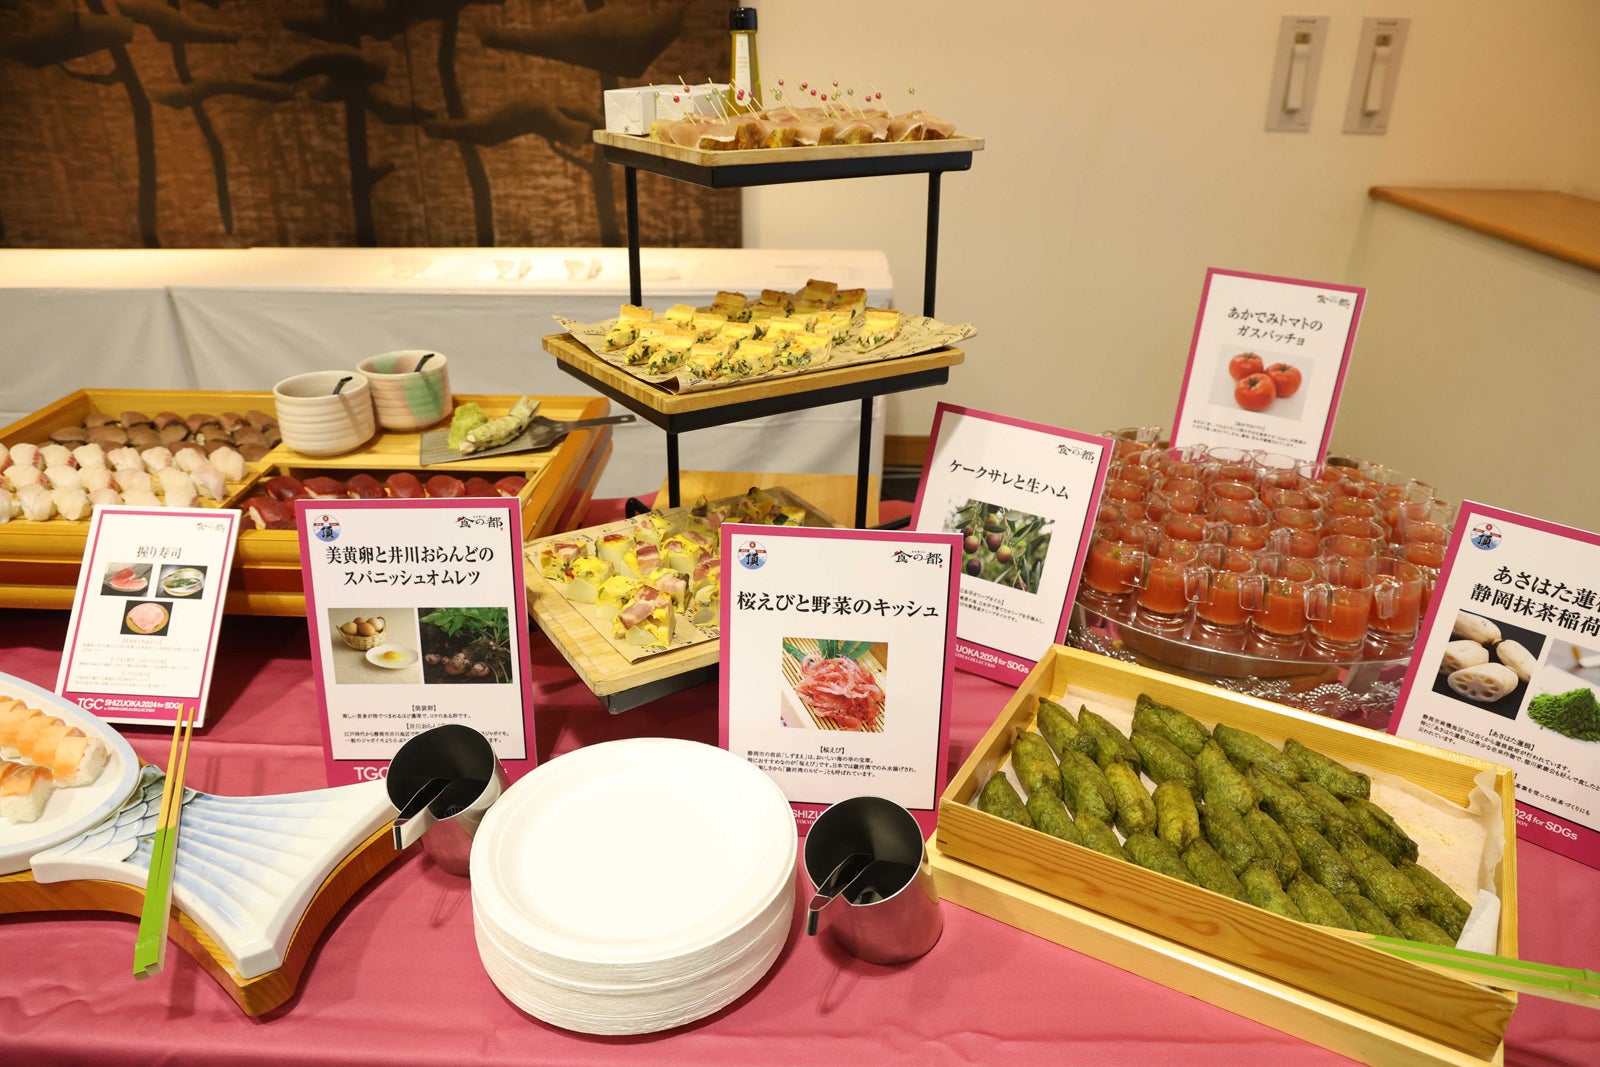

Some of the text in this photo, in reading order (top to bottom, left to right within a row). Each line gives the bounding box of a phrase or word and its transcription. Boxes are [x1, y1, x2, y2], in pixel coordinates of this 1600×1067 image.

[1227, 306, 1323, 332] あかでみトマトの
[949, 459, 1069, 500] ケークサレと生ハム
[456, 515, 503, 529] 食の都
[136, 545, 183, 559] 握り寿司
[325, 545, 494, 565] 美黄卵と井川おらんどの
[892, 549, 943, 567] 食の都
[343, 570, 481, 586] スパニッシュオムレツ
[737, 590, 939, 618] 桜えびと野菜のキッシュ
[1470, 582, 1600, 637] 静岡抹茶稲荷
[979, 651, 999, 664] 2024
[1006, 660, 1030, 674] SDGs
[77, 697, 104, 710] TGC
[164, 702, 181, 710] SDG
[1533, 816, 1545, 826] for
[1545, 821, 1578, 840] SDGs
